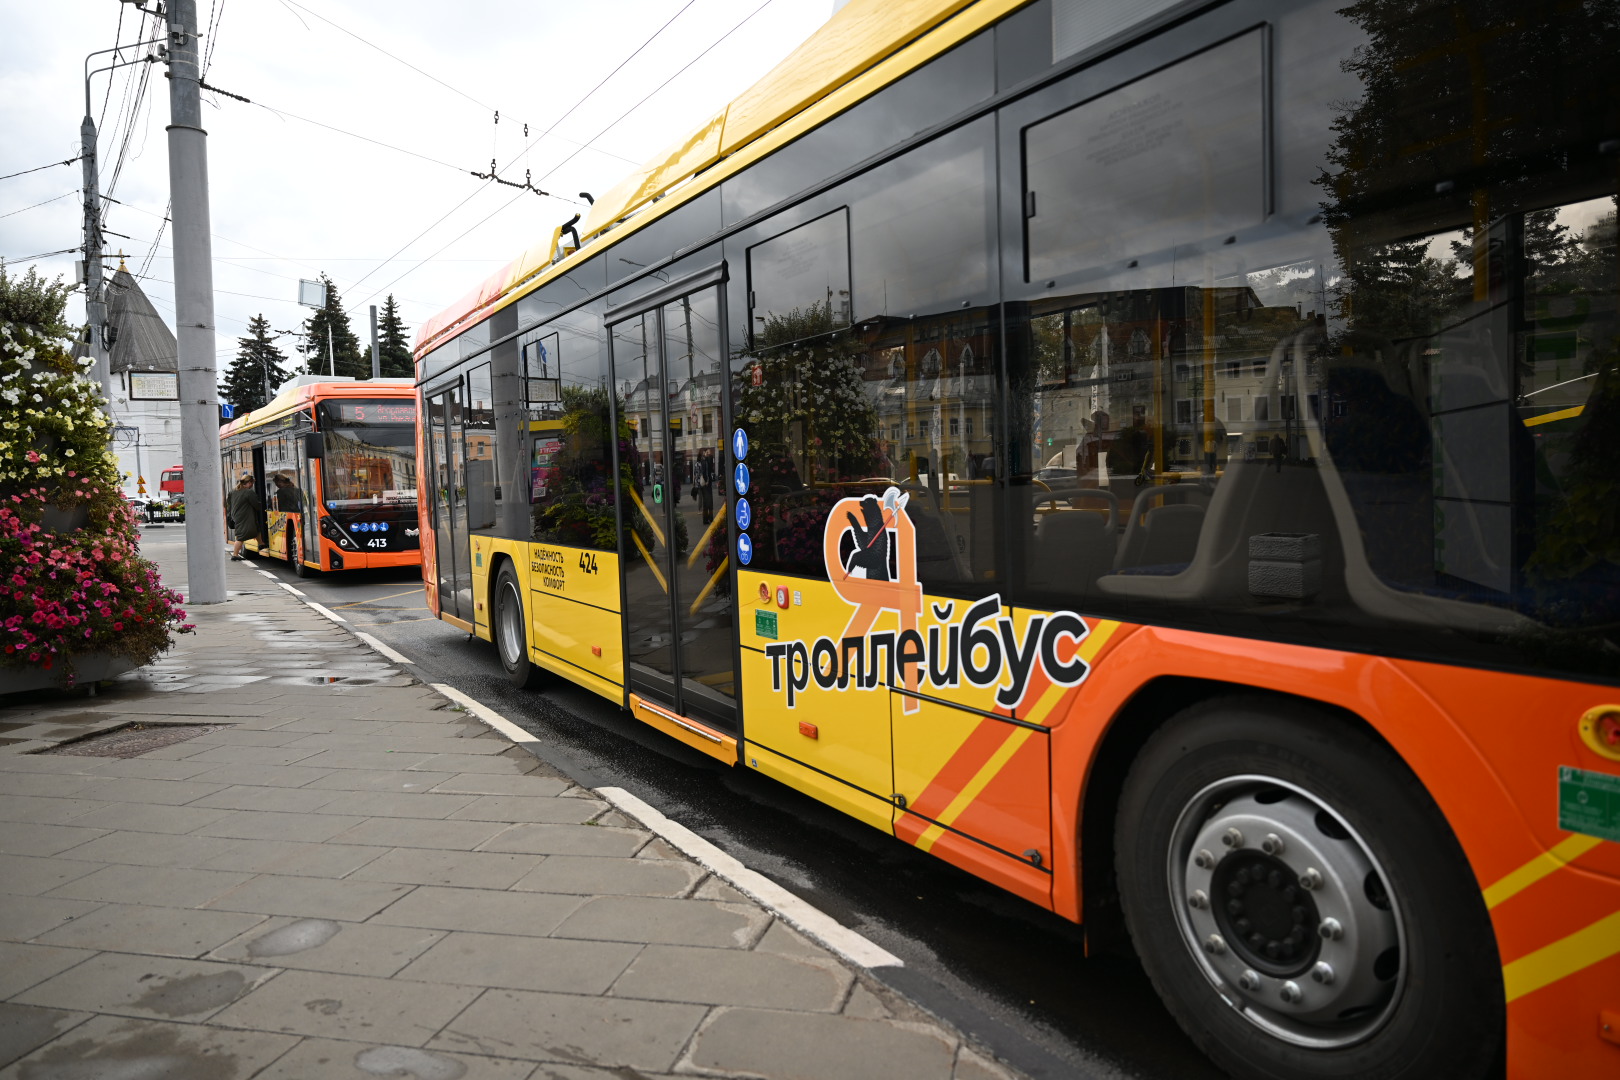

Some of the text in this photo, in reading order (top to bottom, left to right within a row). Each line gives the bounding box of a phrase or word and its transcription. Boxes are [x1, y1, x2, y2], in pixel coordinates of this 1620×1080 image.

[354, 406, 365, 420] 5
[367, 538, 388, 548] 413
[533, 547, 564, 564] НАДЁЖНОСТЬ
[579, 551, 599, 576] 424
[531, 561, 565, 579] БЕЗОПАСНОСТЬ
[543, 576, 566, 592] КОМФОРТ
[765, 594, 1090, 709] троллейбус
